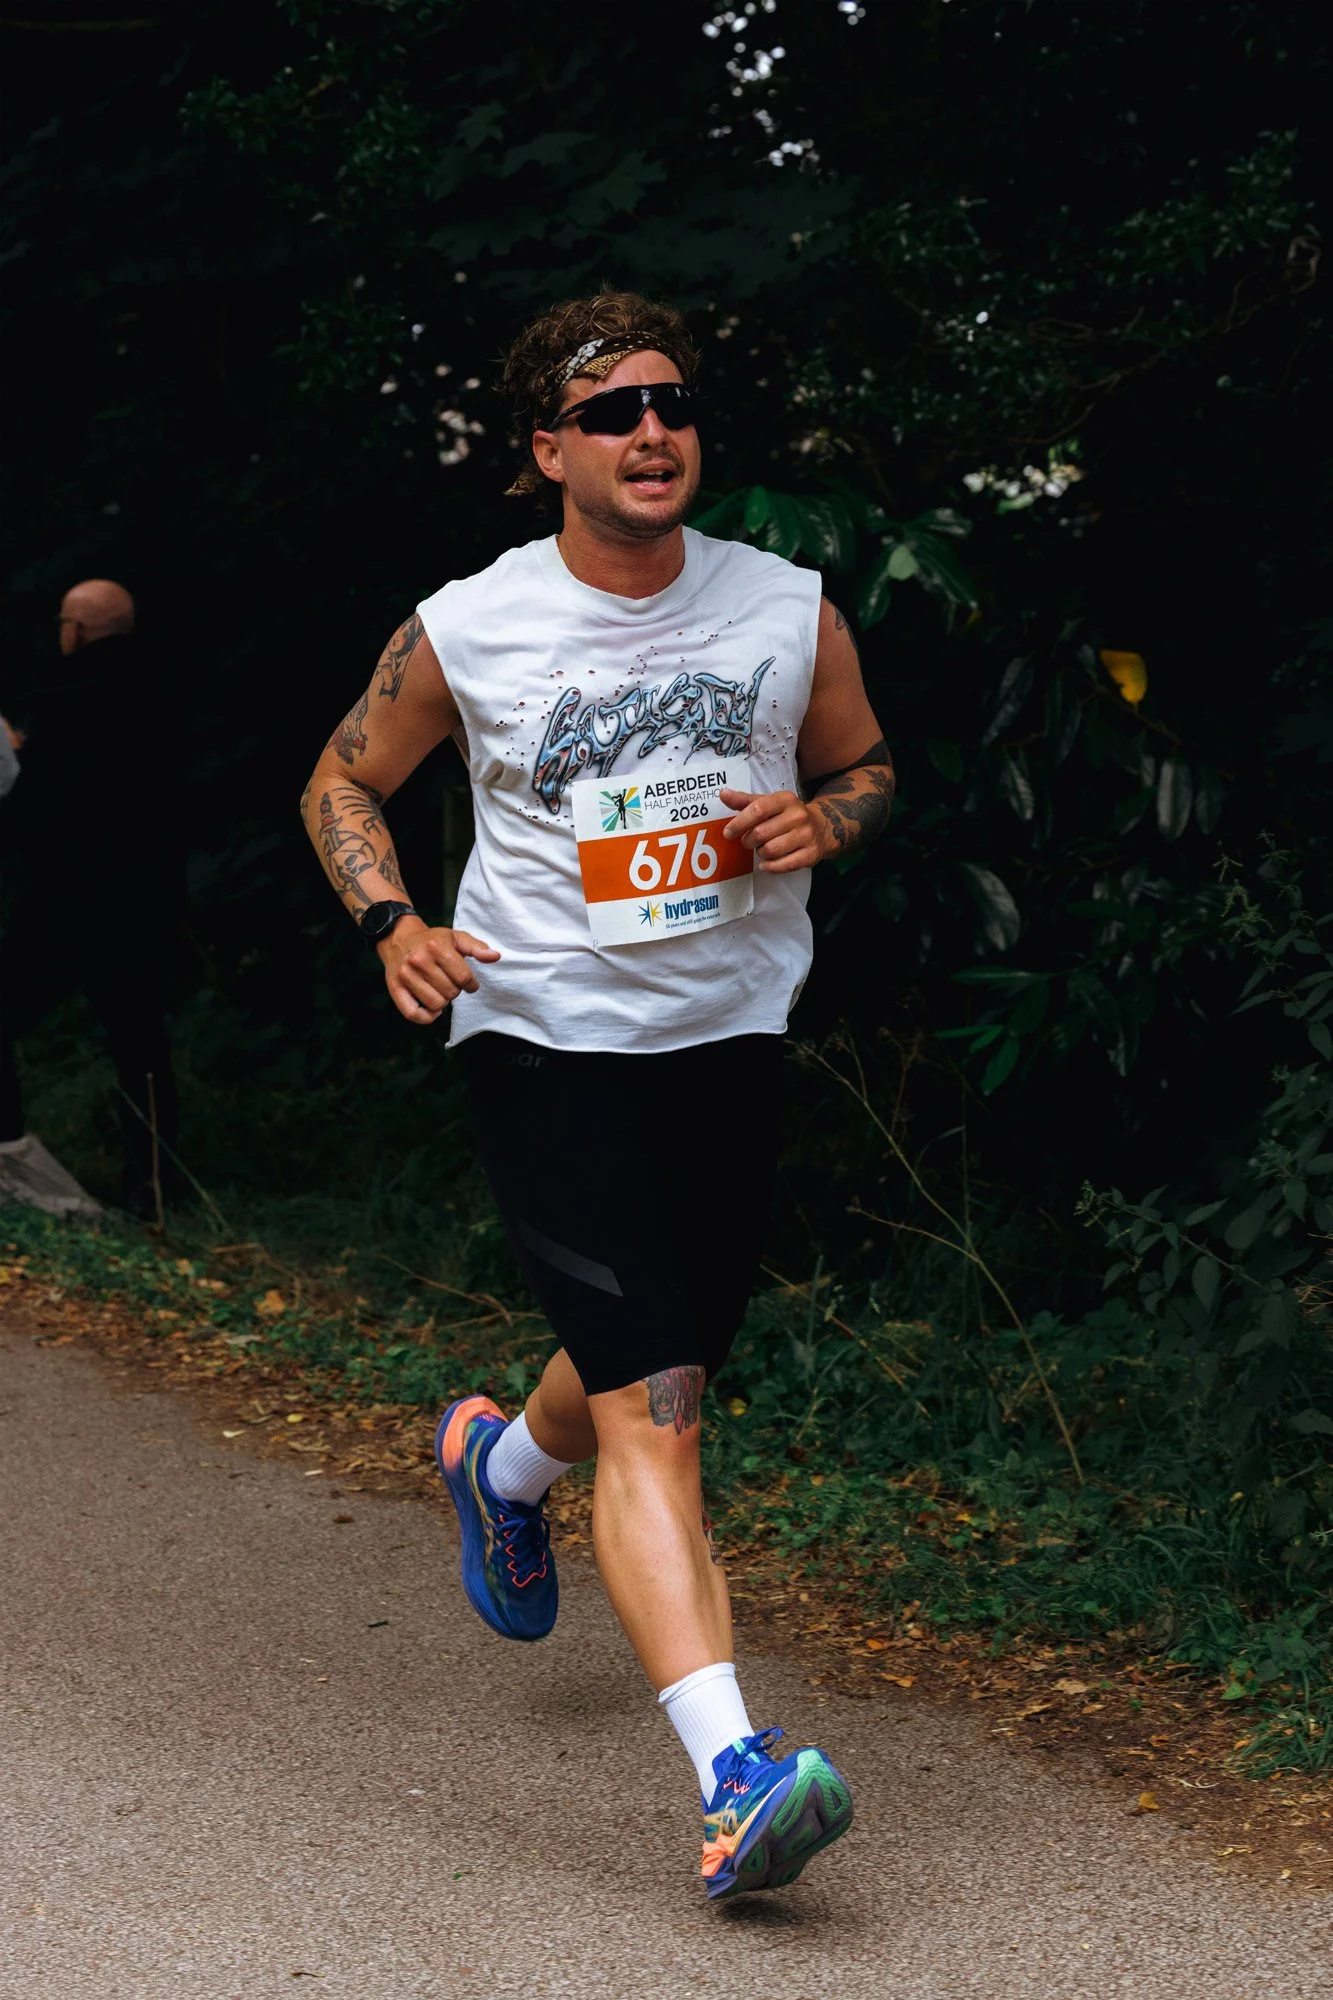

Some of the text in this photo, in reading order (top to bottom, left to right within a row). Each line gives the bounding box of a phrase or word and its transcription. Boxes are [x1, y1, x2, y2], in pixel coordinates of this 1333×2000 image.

[644, 771, 727, 799] ABERDEEN
[644, 786, 728, 811] HALF MARATHO
[669, 803, 709, 822] 2026
[628, 829, 718, 891] 676
[664, 894, 719, 920] hydrasun
